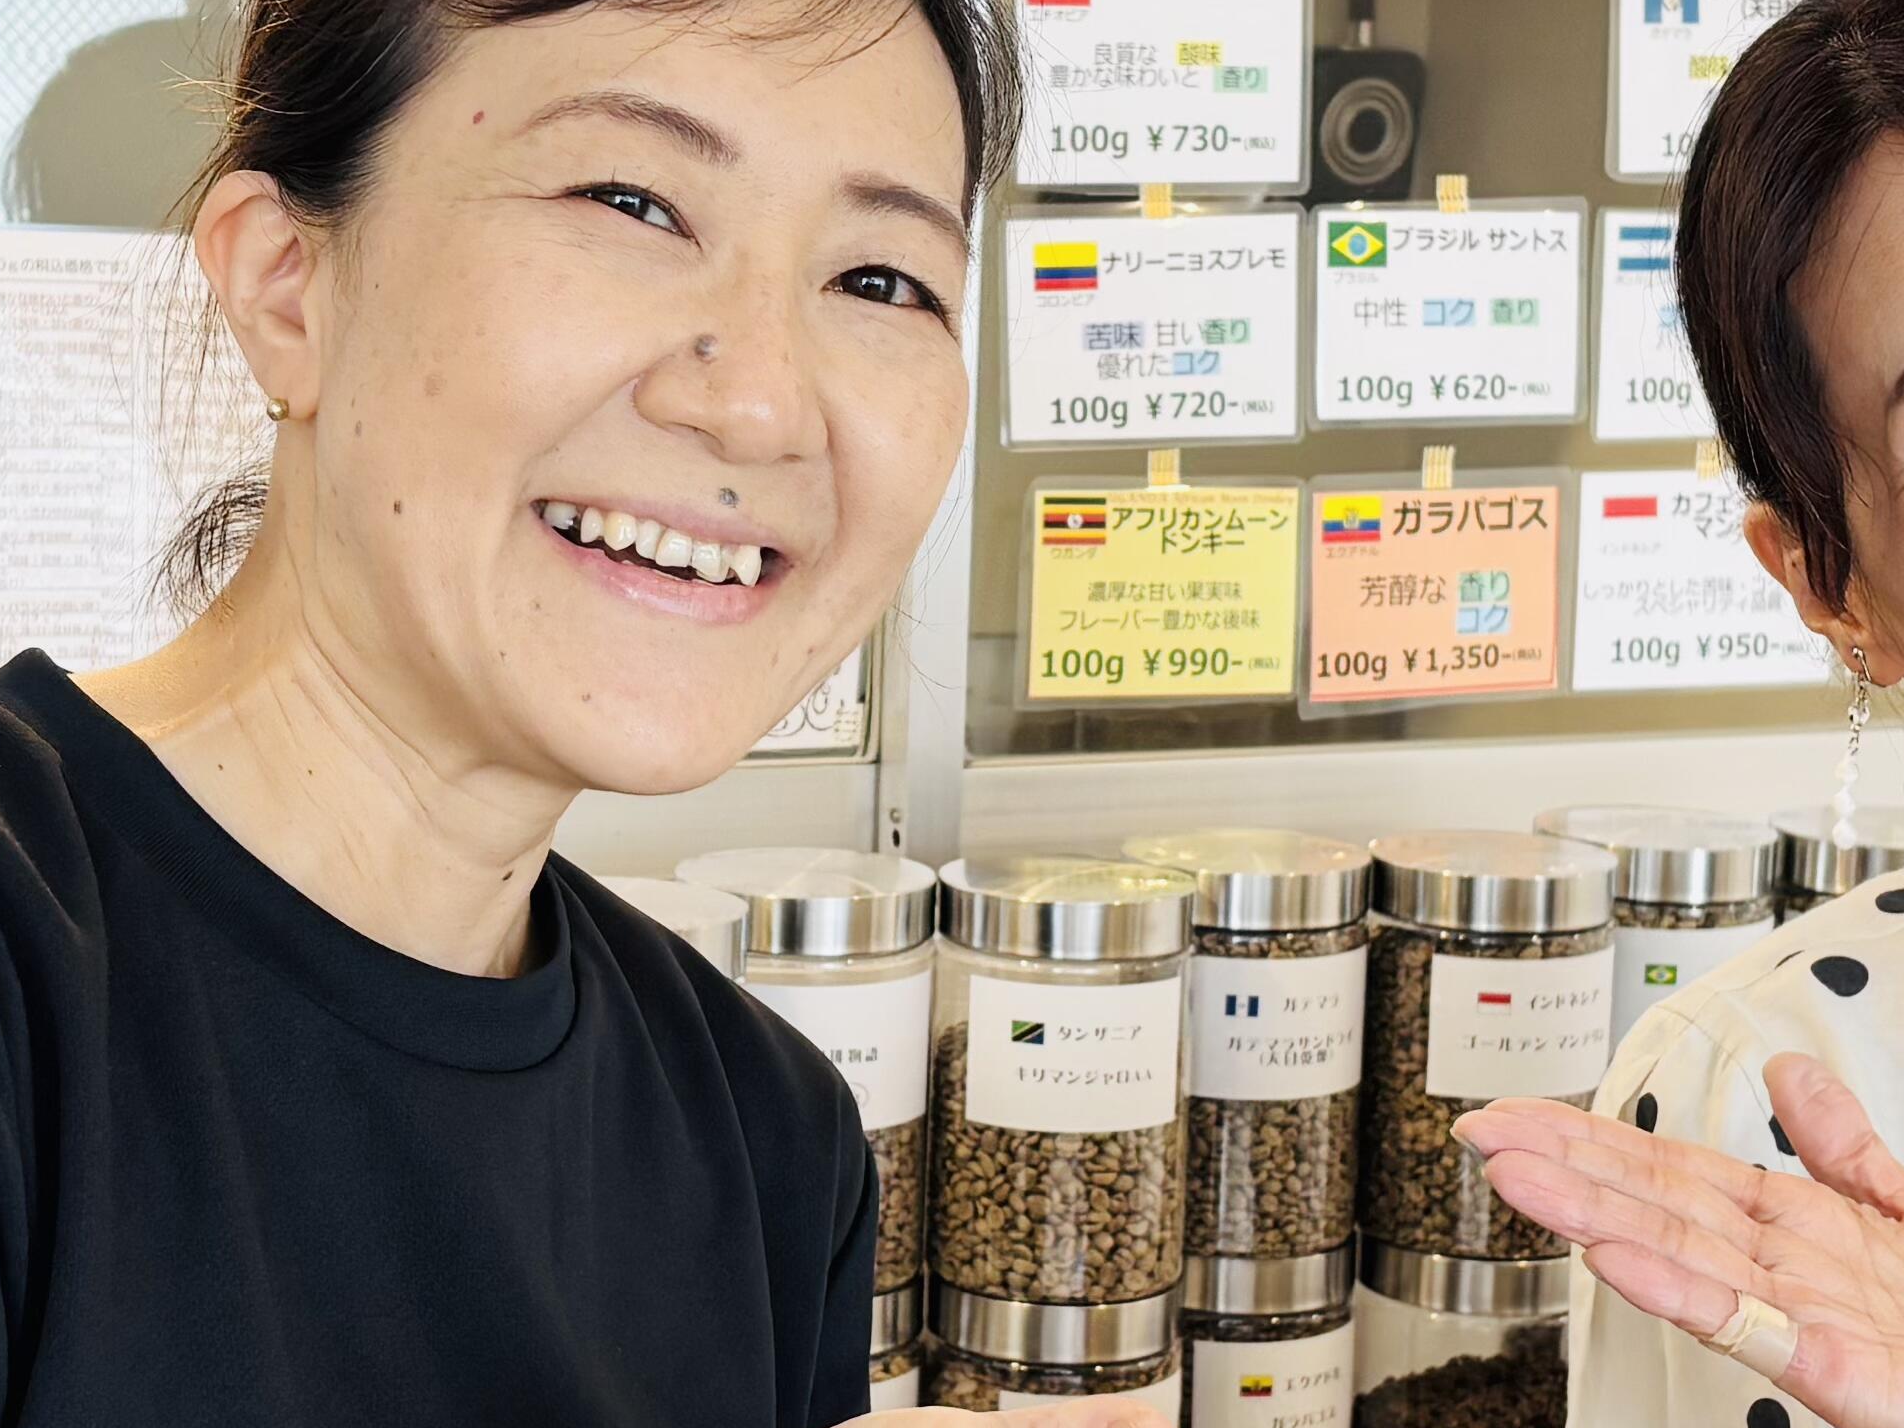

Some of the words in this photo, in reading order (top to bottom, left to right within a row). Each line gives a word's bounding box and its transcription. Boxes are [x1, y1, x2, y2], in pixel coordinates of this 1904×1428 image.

[1093, 42, 1157, 66] 良質な
[1049, 64, 1200, 89] 豊かな味わいと
[1221, 67, 1262, 90] 香り
[1050, 125, 1129, 159] 100g
[1392, 226, 1480, 252] ブラジル
[1487, 228, 1568, 252] サントス
[1353, 297, 1408, 328] 中性
[1422, 298, 1476, 328] コク
[1492, 299, 1536, 324] 香り
[1085, 322, 1142, 351] 苦味
[1336, 375, 1414, 408] 100g
[1626, 377, 1692, 410] 100g
[1049, 396, 1128, 429] 100g
[1111, 507, 1290, 532] アフリカンムーン
[1392, 495, 1549, 537] ガラパゴス
[1160, 529, 1246, 555] ドンキー
[1087, 580, 1243, 603] 濃厚な甘い果実味
[1359, 573, 1447, 608] 芳醇な
[1459, 570, 1511, 604] 香り
[1057, 608, 1260, 632] フレーバー豊かな後味
[1457, 604, 1509, 635] コク
[1041, 648, 1125, 685] 100g
[1316, 651, 1388, 682] 100g
[1610, 637, 1682, 668] 100g
[1282, 992, 1342, 1013] ガテマラ
[1056, 1024, 1144, 1043] タンザニア
